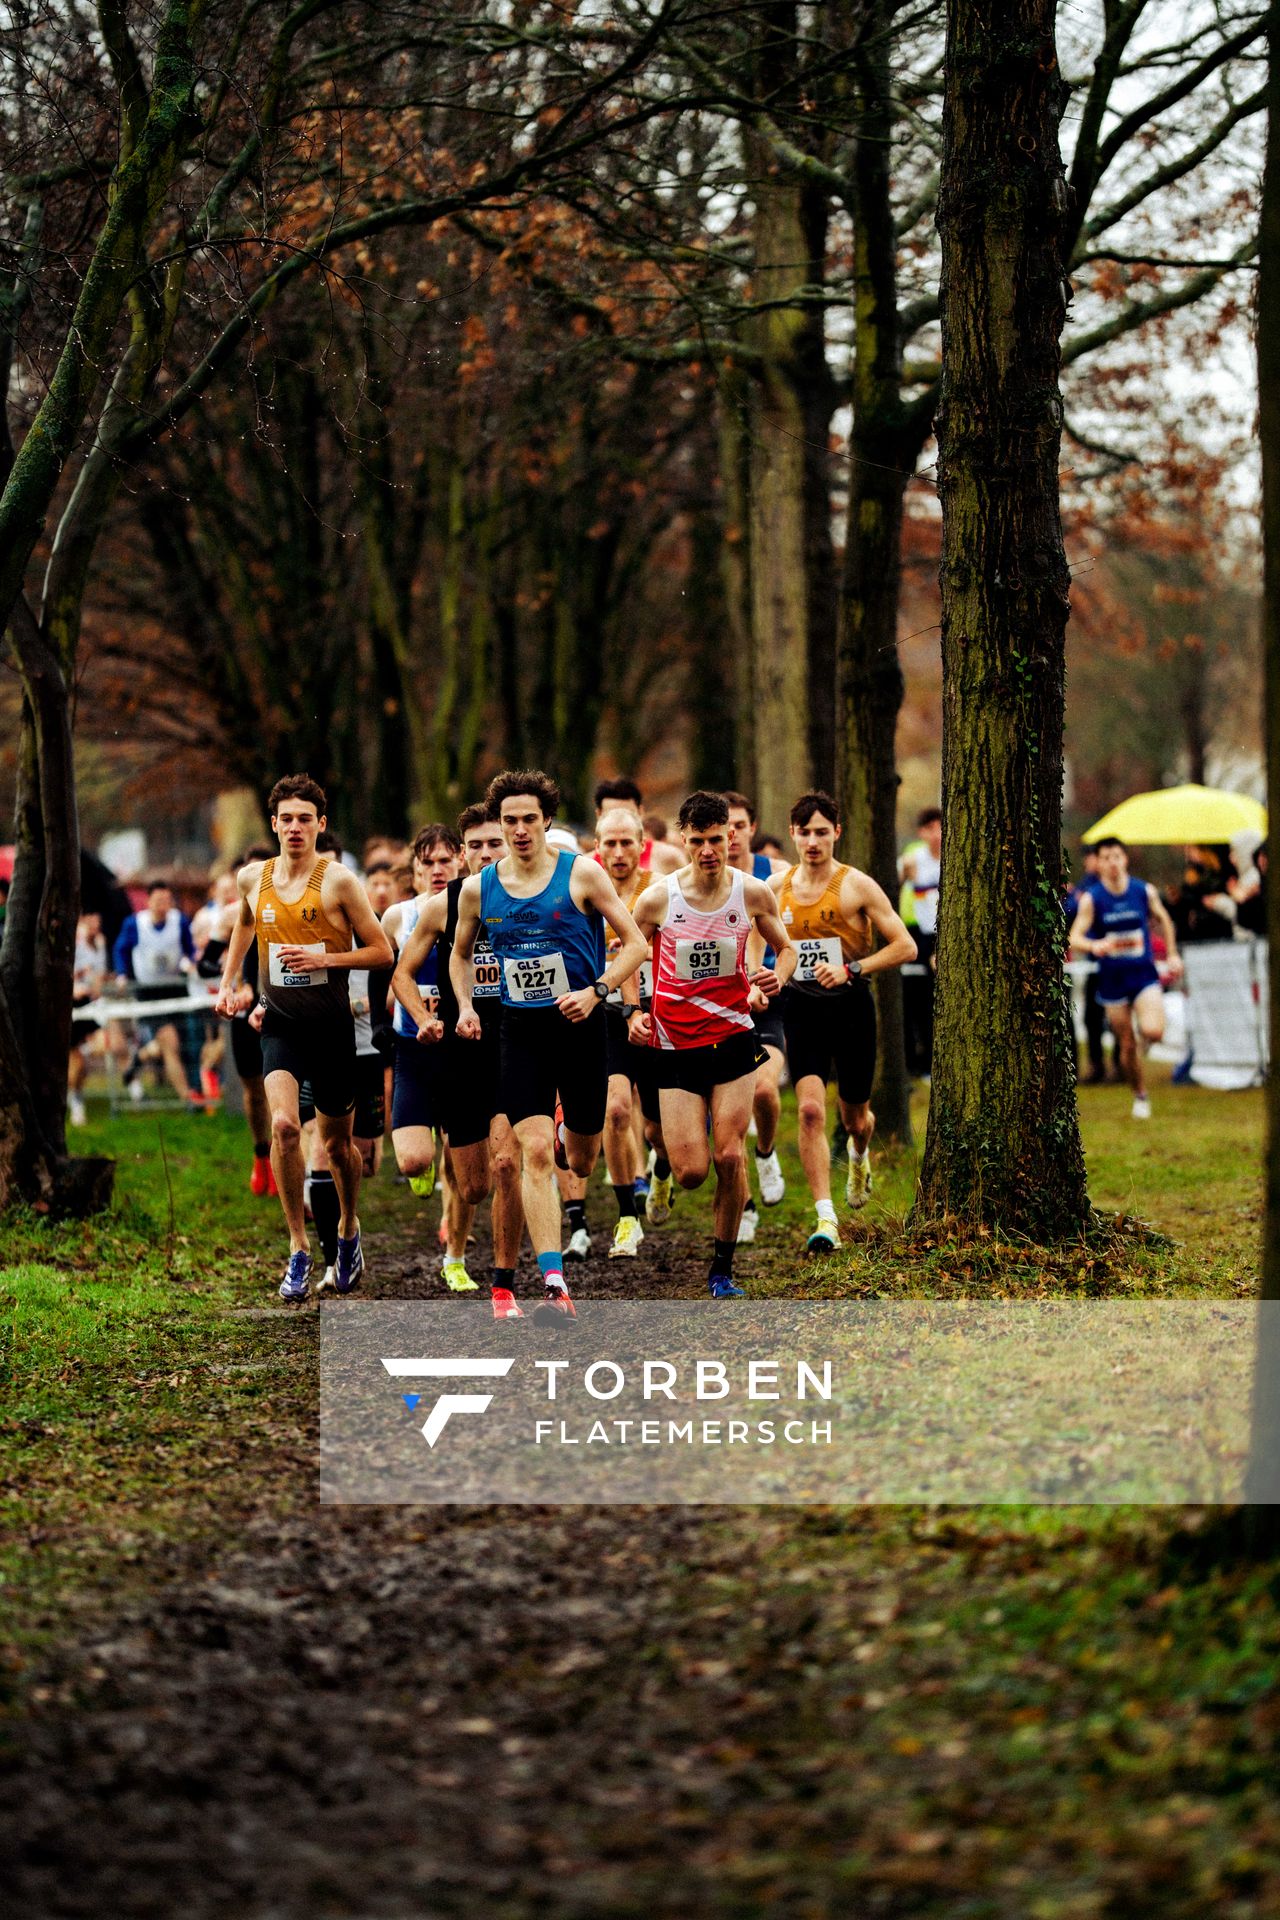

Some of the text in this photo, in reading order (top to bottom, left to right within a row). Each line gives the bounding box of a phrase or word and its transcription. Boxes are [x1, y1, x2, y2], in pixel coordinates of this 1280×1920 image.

[693, 941, 717, 951] GLS
[801, 941, 821, 951] GLS
[474, 955, 496, 965] GLS
[689, 951, 721, 968] 931
[799, 952, 829, 968] 225
[517, 960, 541, 970] GLS
[512, 968, 556, 989] 1227
